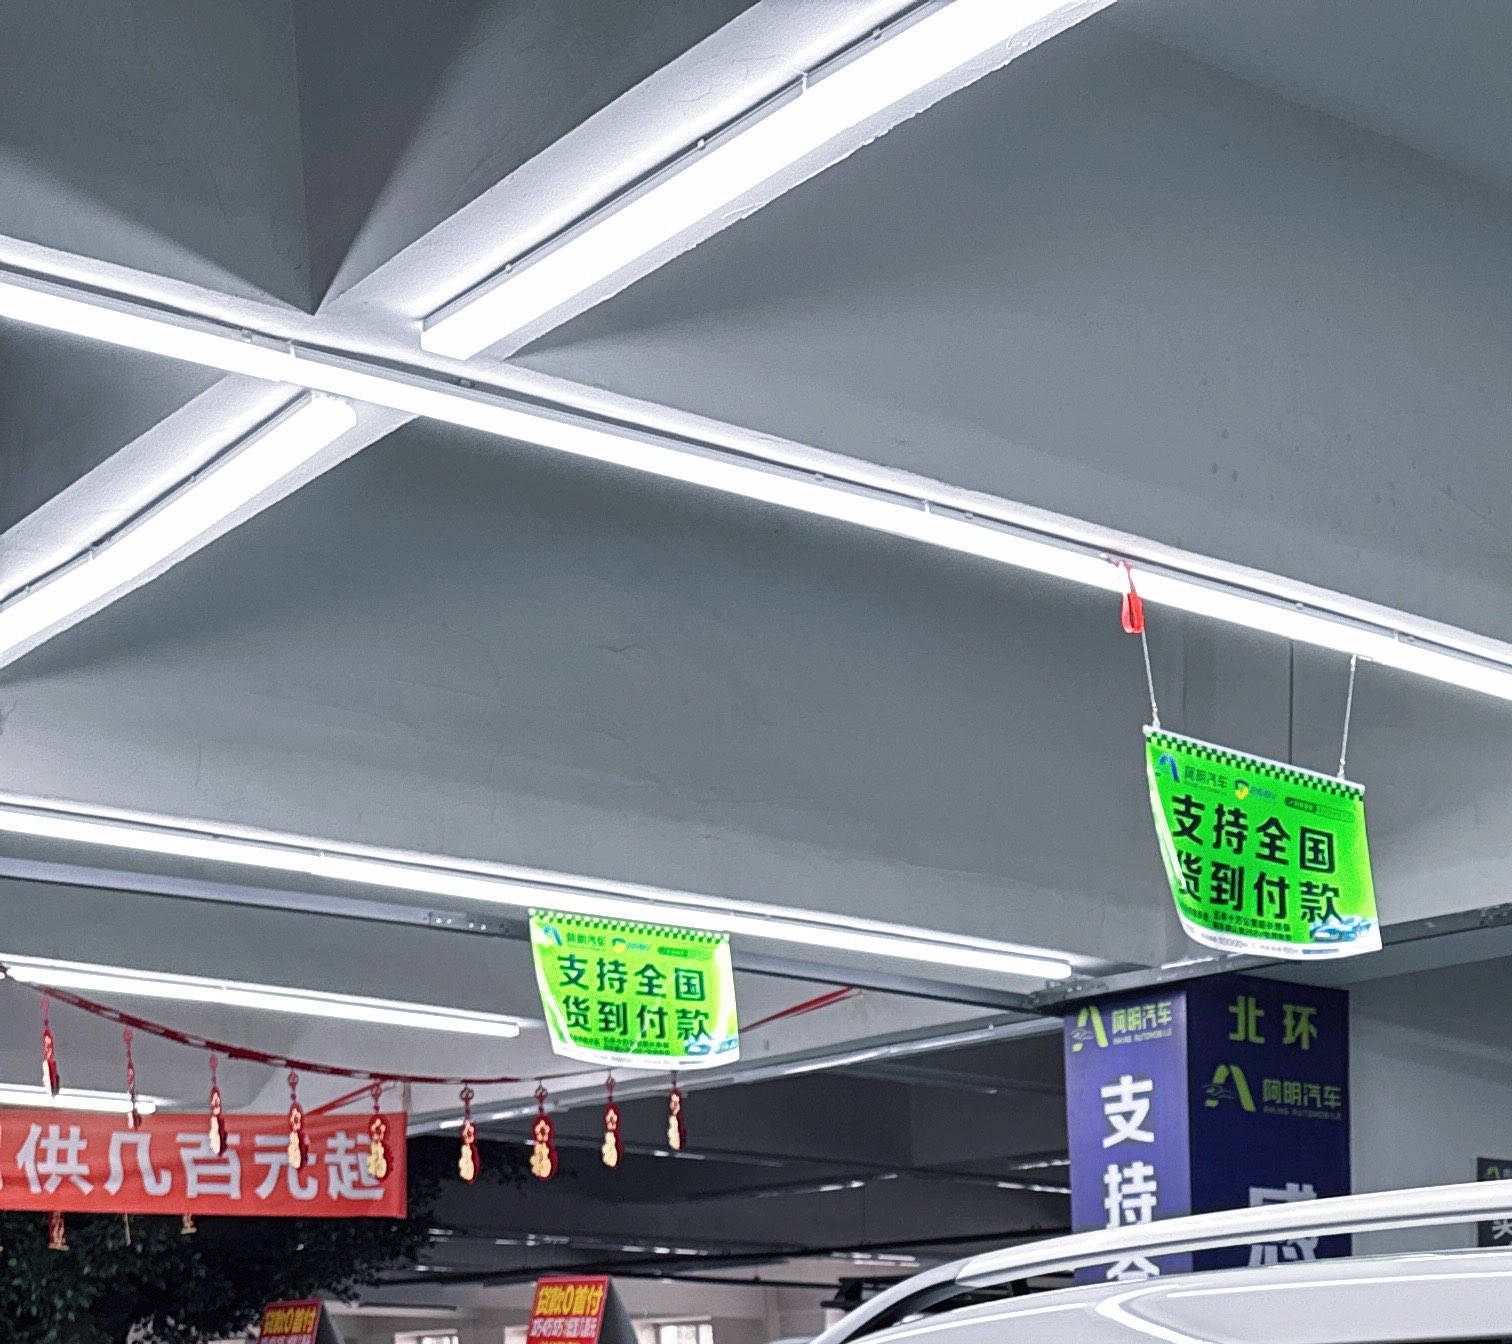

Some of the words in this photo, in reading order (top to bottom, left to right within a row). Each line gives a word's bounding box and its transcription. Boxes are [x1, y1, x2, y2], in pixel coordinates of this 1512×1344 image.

[1171, 794, 1337, 875] 支持全国
[1175, 849, 1343, 924] 货到付款
[557, 953, 707, 1002] 支持全国
[562, 995, 713, 1042] 货到付款
[1111, 1001, 1173, 1034] 阿明汽车
[1228, 995, 1318, 1050] 北环
[1262, 1078, 1342, 1109] 阿明汽车
[0, 1123, 386, 1201] 供几百元起
